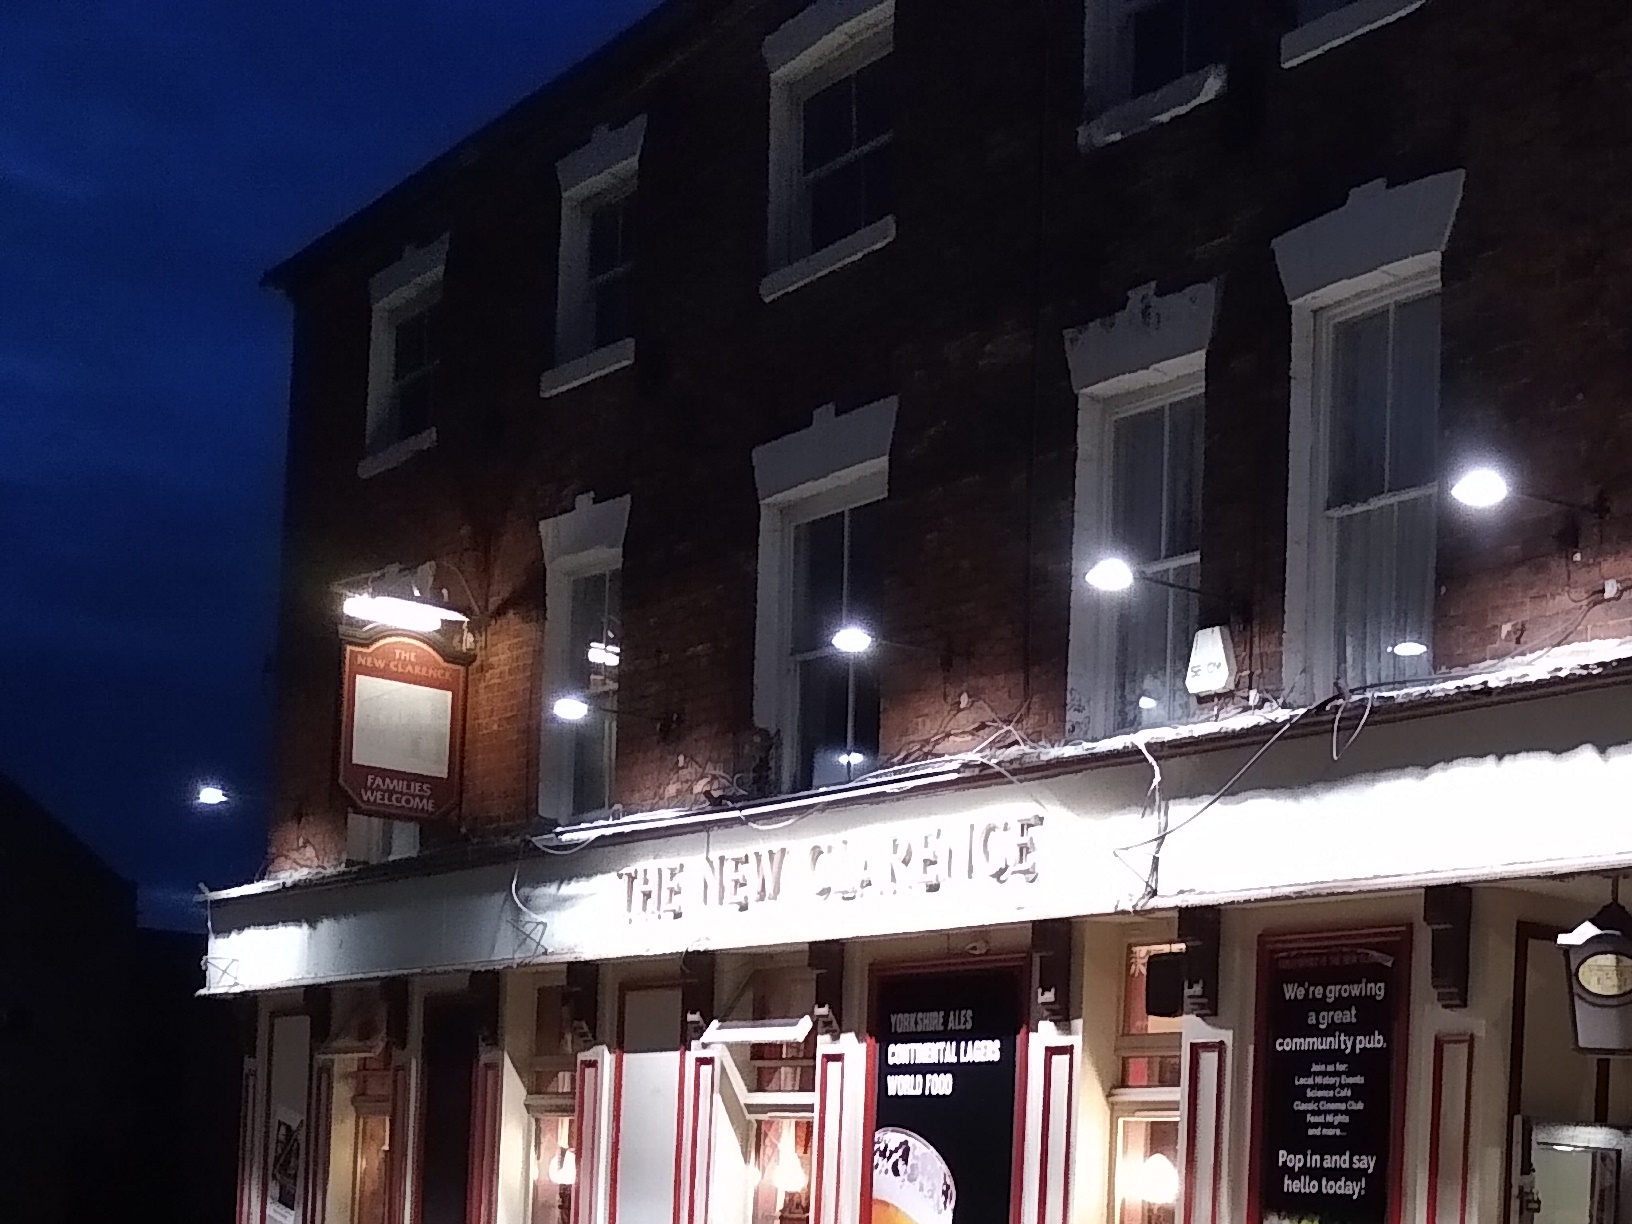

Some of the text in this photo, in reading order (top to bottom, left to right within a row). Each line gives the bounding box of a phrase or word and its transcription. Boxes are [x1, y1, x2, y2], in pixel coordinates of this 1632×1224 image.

[356, 654, 453, 680] NEW CLARENCE
[394, 649, 417, 661] THE
[367, 774, 432, 796] FAMILIES
[361, 788, 436, 812] WELCOME
[616, 862, 685, 925] THE
[703, 847, 788, 913] NEW
[1282, 978, 1385, 1003] We're growing
[890, 1009, 973, 1033] YORKSHIRE ALES
[1307, 1005, 1357, 1029] a great
[887, 1039, 1001, 1065] CONTINENTAL LAGERS
[1275, 1030, 1387, 1055] community pub.
[886, 1072, 953, 1096] WORLD FOOD
[1278, 1149, 1376, 1174] Pop in and say
[1283, 1174, 1366, 1200] hello today!
